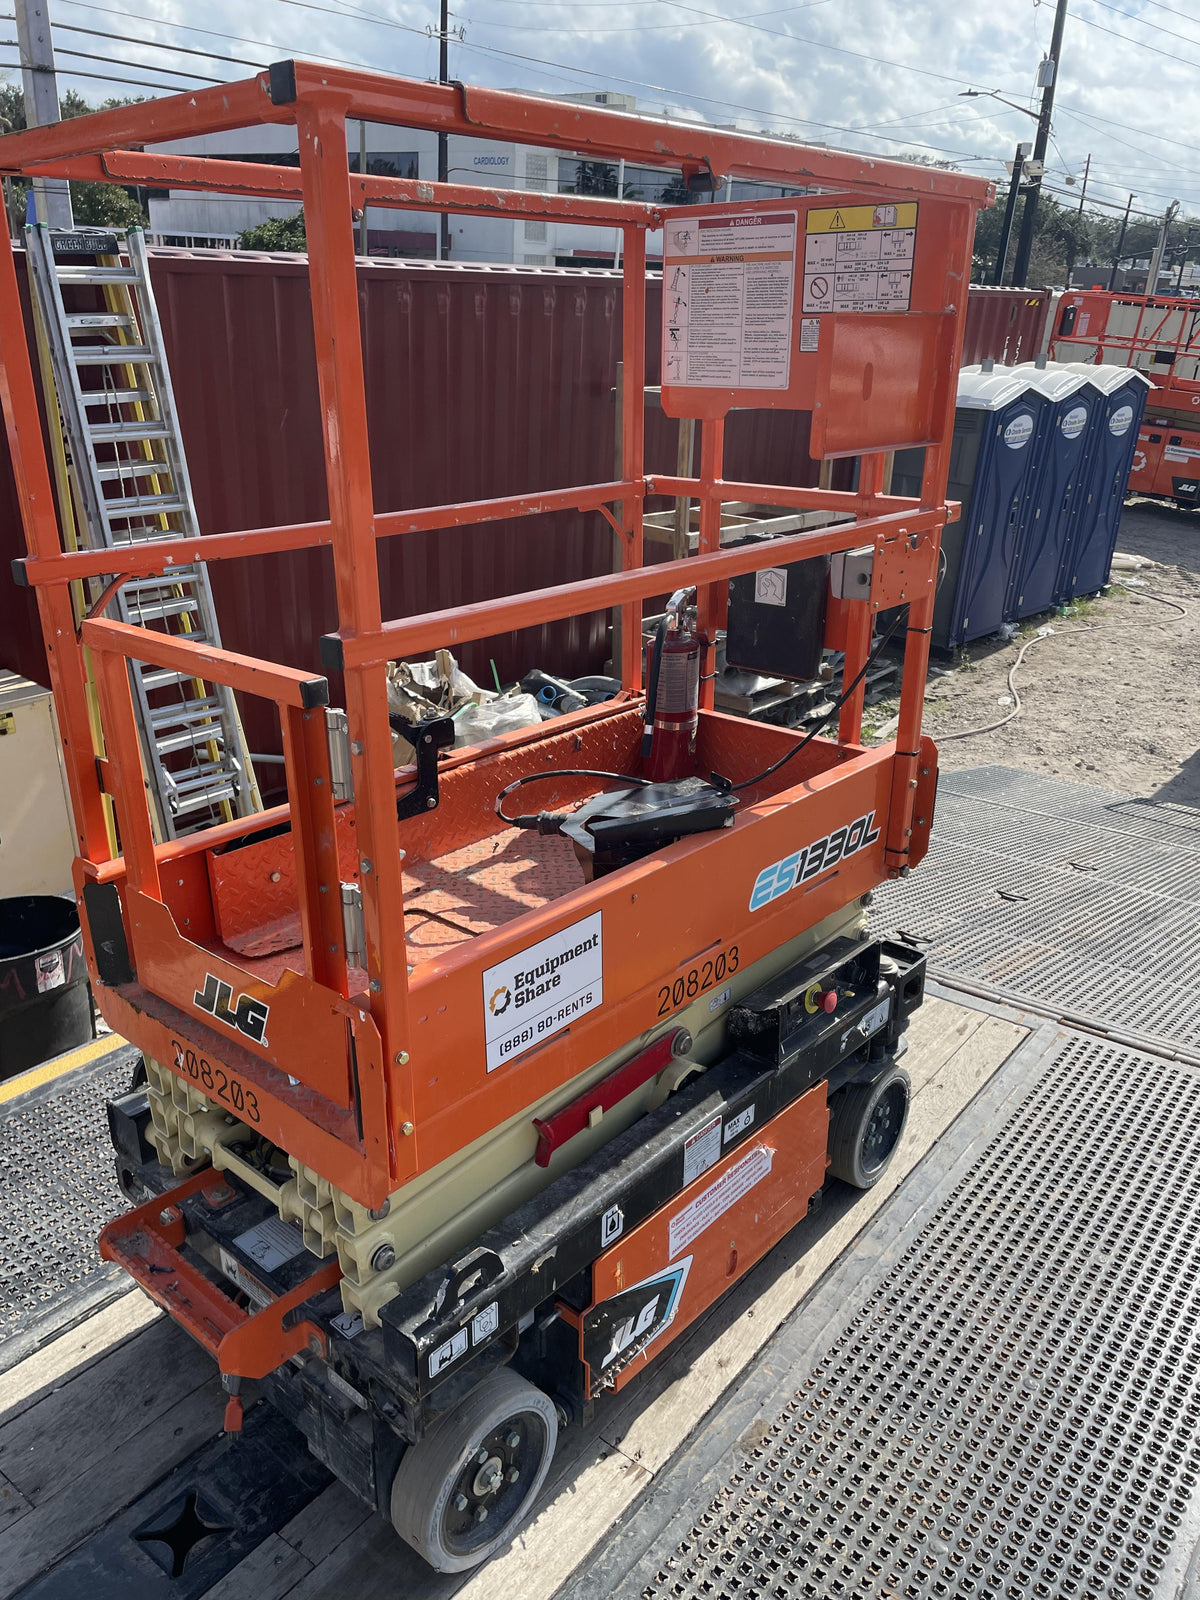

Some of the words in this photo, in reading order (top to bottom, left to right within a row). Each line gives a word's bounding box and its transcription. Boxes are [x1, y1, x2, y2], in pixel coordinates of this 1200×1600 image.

[473, 156, 510, 165] CARDIOLOGY
[735, 217, 762, 226] DANGER
[55, 238, 83, 251] GREEN
[85, 238, 107, 251] BULL
[716, 255, 745, 263] WARNING
[1178, 483, 1197, 493] JLG
[750, 811, 880, 911] ES1330L
[514, 933, 599, 991] Equipment
[514, 974, 561, 1009] Share
[657, 946, 739, 1017] 208203
[193, 972, 270, 1045] JLG
[500, 1027, 533, 1056] (888)
[537, 992, 593, 1033] 80-RENTS
[171, 1040, 260, 1123] 208203
[727, 1117, 740, 1132] MAX
[695, 1178, 727, 1208] CUSTOMER
[601, 1293, 660, 1369] JLG
